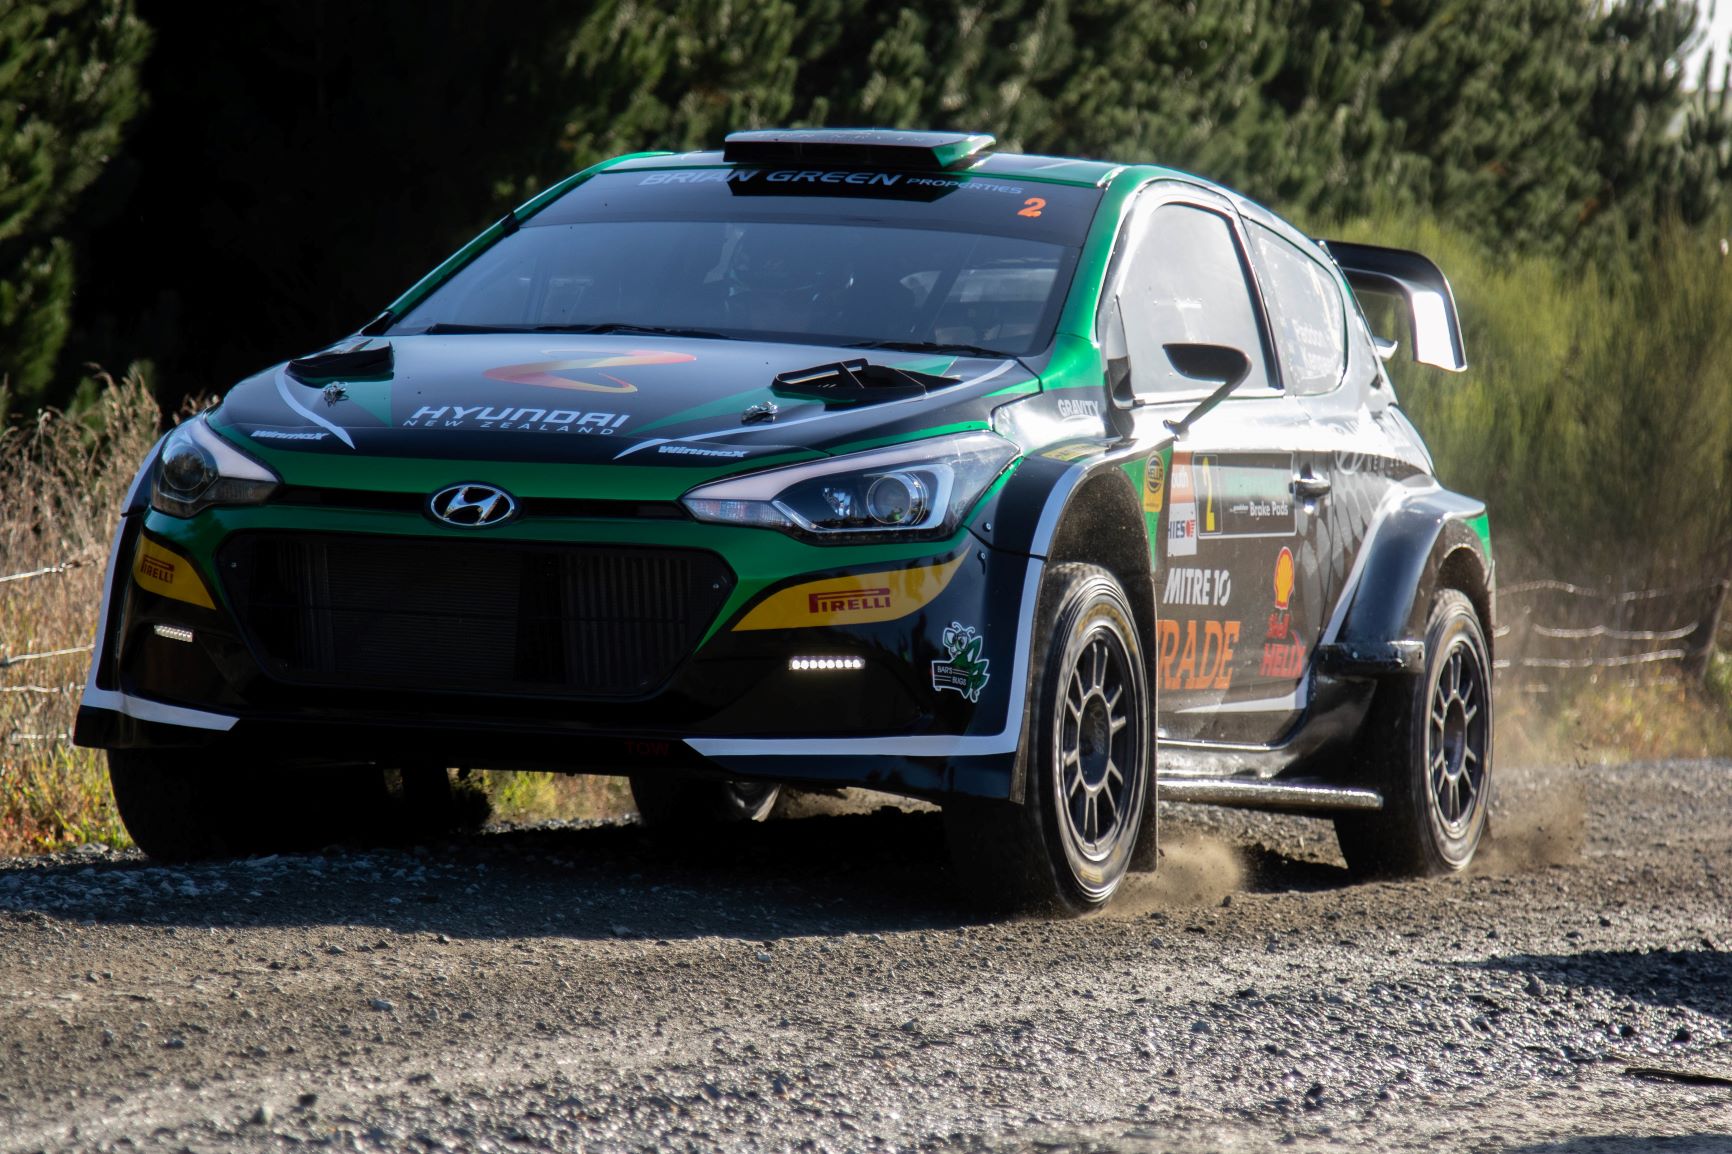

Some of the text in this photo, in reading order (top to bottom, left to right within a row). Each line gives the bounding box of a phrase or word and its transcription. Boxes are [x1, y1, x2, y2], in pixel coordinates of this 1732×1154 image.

[640, 169, 1024, 194] BRIAN GREEN PROPERTIES
[1017, 197, 1046, 218] 2
[411, 405, 630, 428] HYUNDAI
[1058, 399, 1099, 418] GRAVITY
[250, 430, 330, 441] Winmax
[402, 419, 615, 435] NEW ZEALAND
[658, 445, 750, 458] Winmax
[1250, 500, 1271, 520] Brake
[1271, 501, 1289, 516] Pads
[140, 554, 175, 584] PIRELLI
[1163, 568, 1231, 606] MITRE 10
[808, 587, 891, 613] PIRELLI
